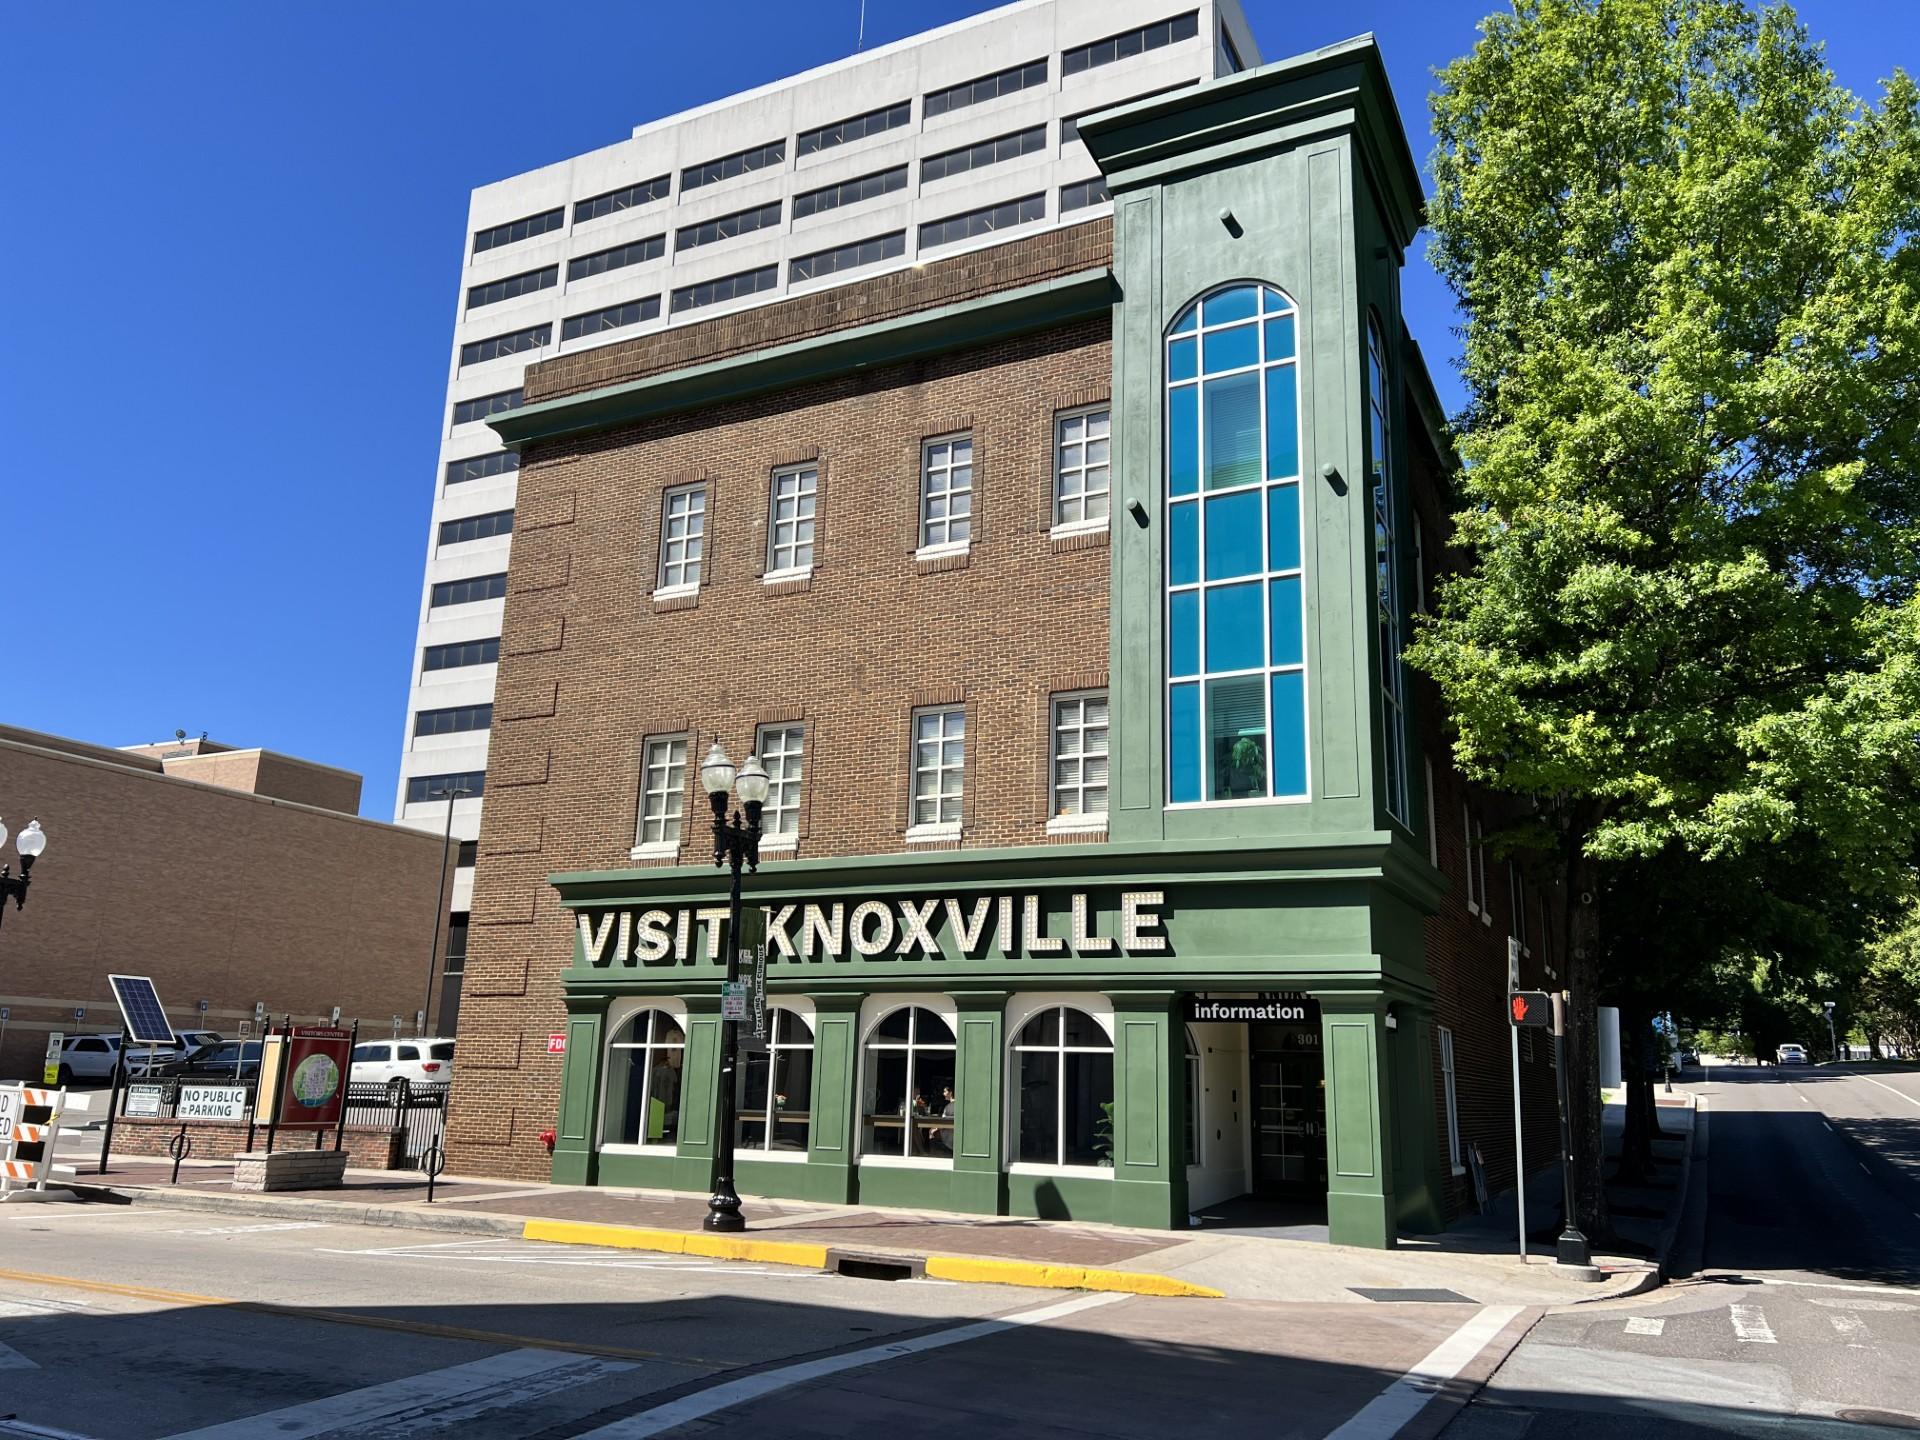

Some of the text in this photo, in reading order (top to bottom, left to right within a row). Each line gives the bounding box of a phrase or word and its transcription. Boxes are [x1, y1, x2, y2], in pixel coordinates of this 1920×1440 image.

[578, 891, 1166, 961] VISIT KNOXVILLE
[755, 997, 763, 1028] CALLING
[1195, 1002, 1304, 1019] information
[1297, 1033, 1319, 1045] 301
[183, 1090, 243, 1103] NO PUBLIC
[189, 1104, 232, 1117] PARKING
